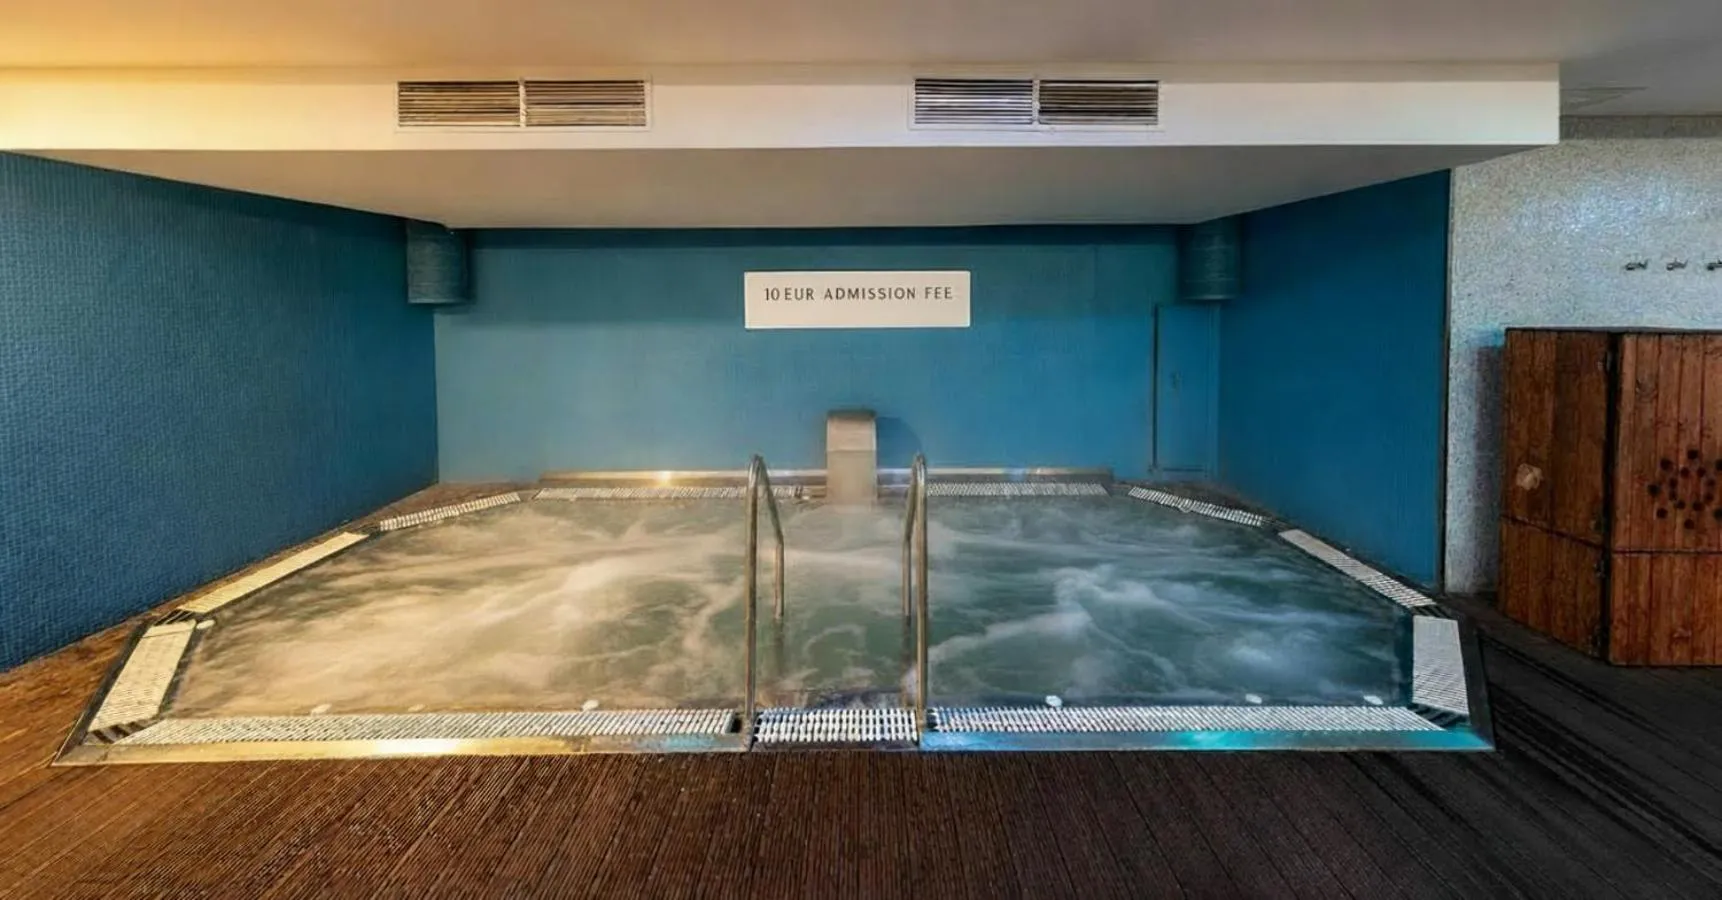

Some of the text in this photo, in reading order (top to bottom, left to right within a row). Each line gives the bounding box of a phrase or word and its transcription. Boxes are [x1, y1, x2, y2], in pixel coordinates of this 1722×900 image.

[764, 286, 953, 301] 10 EUR ADMISSION FEE
